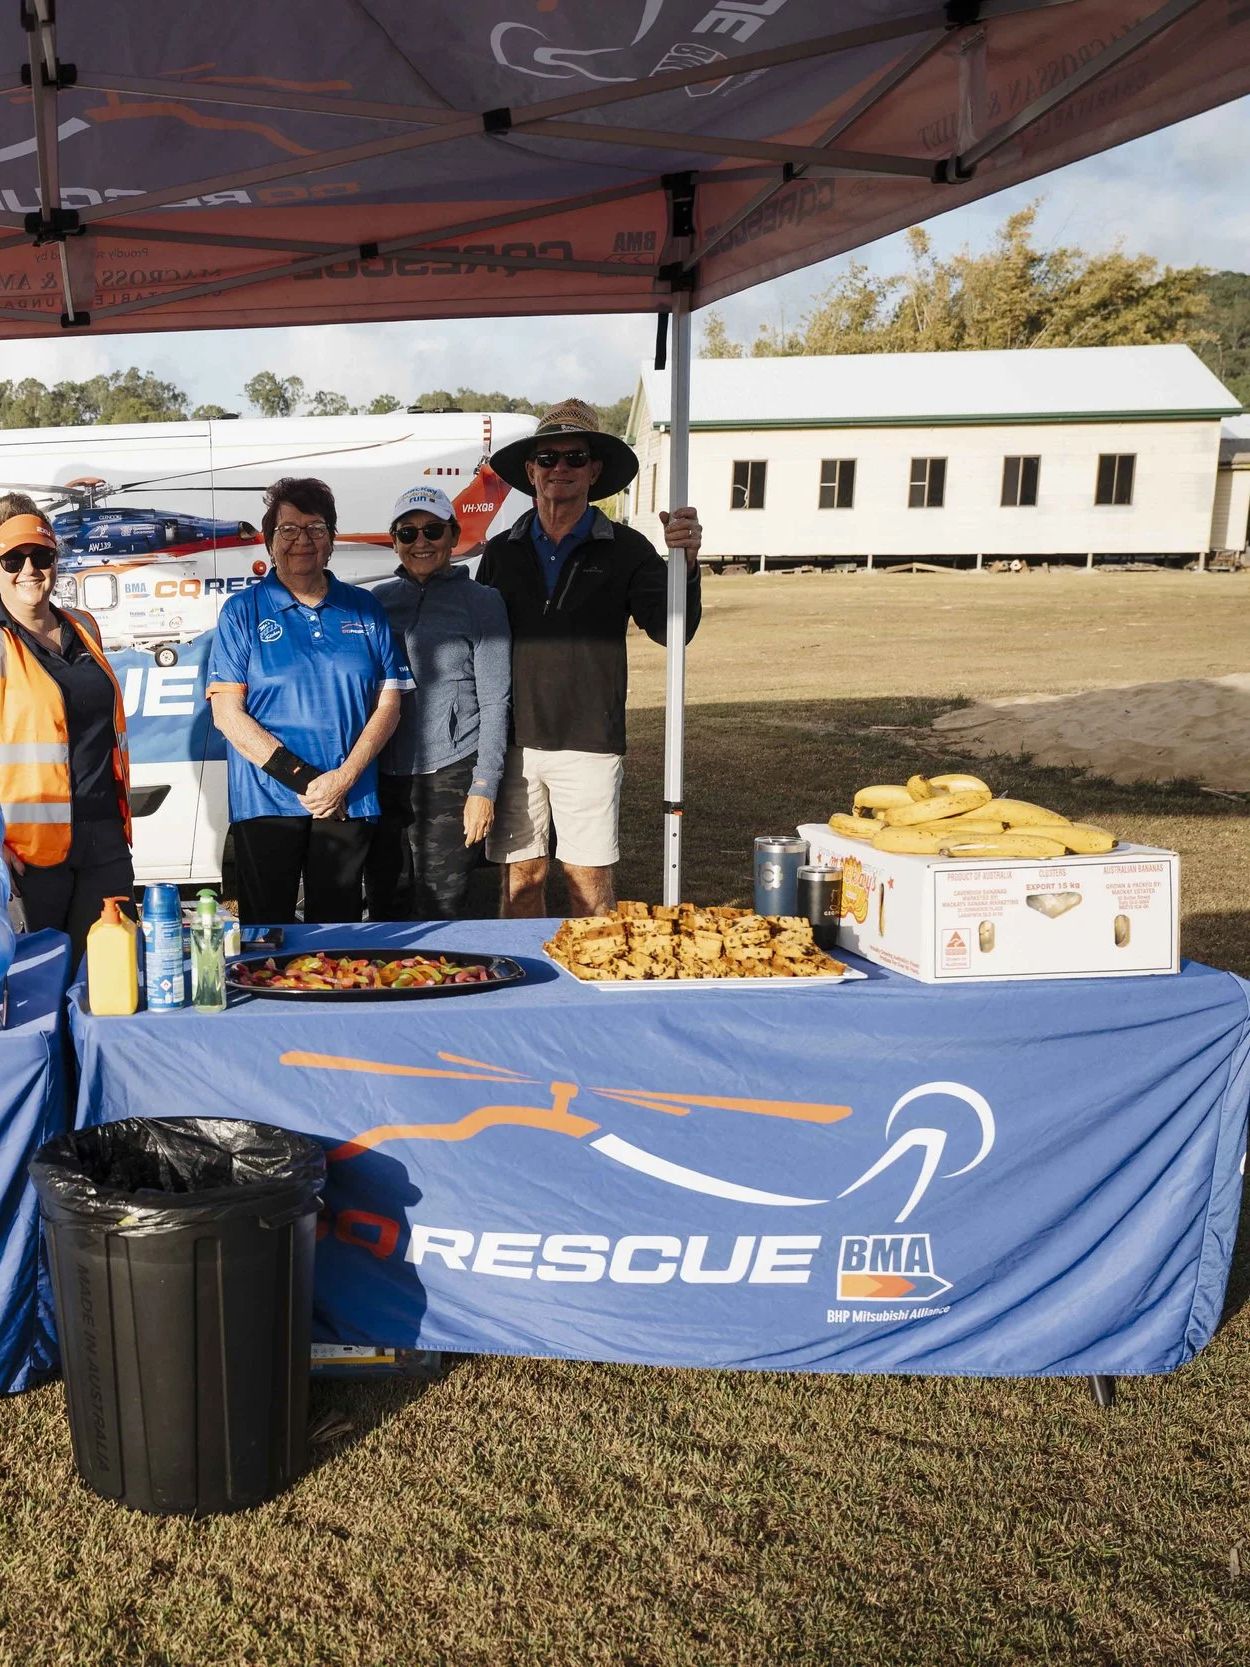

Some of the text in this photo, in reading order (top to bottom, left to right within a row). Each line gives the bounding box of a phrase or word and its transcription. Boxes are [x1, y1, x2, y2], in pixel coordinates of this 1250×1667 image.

[462, 503, 494, 513] VH-XQ8
[124, 582, 147, 593] BMA
[983, 871, 1013, 880] AUSTRALIA
[1103, 864, 1164, 874] AUSTRALIAN BANANAS
[316, 1208, 823, 1285] QRESCUE
[840, 1236, 931, 1273] BMA
[827, 1305, 950, 1323] BHP Mitsubishi Alliance
[78, 1264, 110, 1473] MADE IN AUSTRALIA
